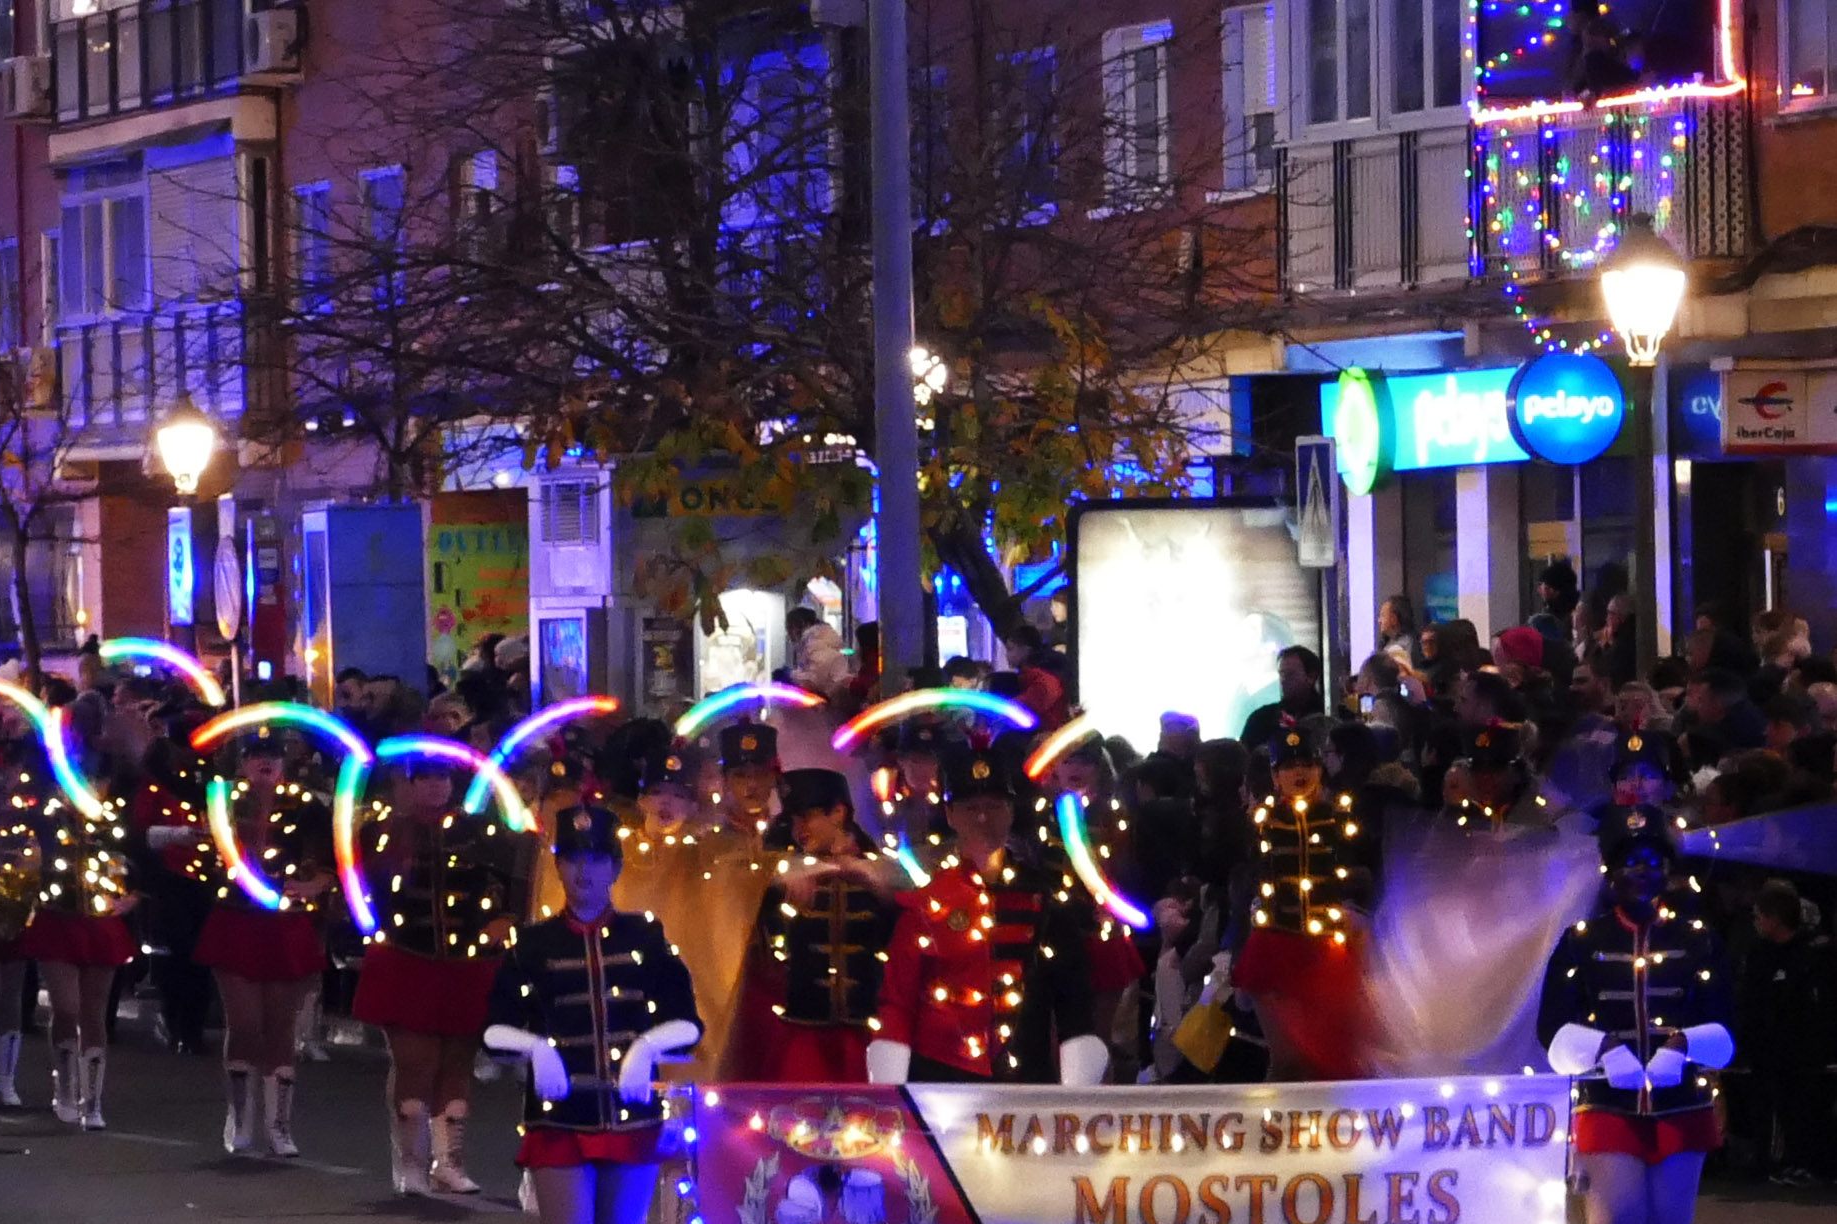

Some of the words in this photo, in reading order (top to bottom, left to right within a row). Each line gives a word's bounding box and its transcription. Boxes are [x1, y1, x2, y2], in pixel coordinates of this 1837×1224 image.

[1523, 389, 1615, 424] pelayo
[975, 1112, 1246, 1155] MARCHING
[1259, 1107, 1406, 1153] SHOW
[1422, 1102, 1557, 1150] BAND
